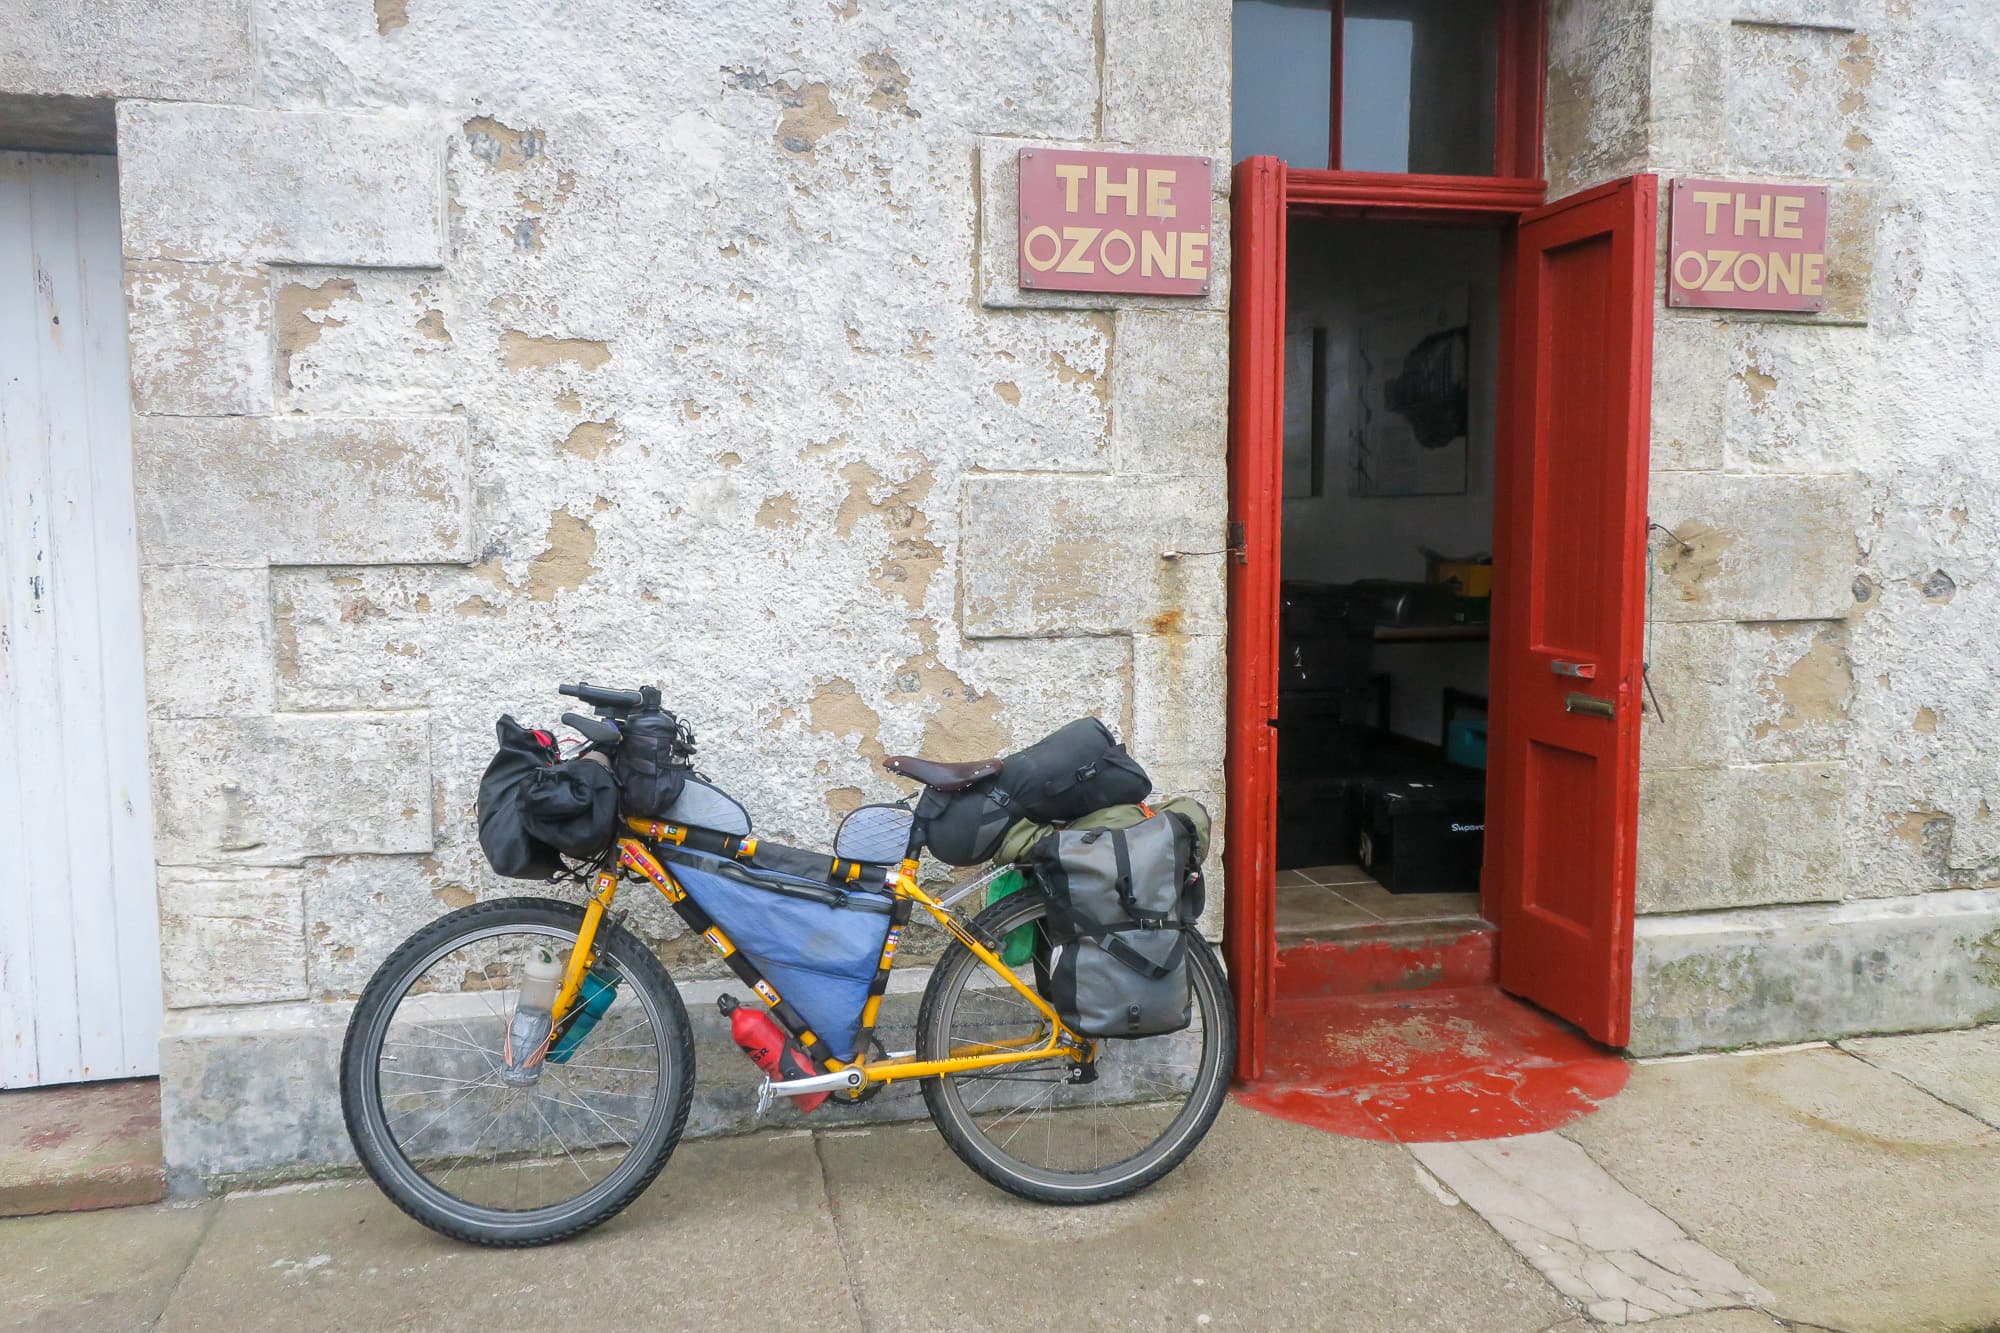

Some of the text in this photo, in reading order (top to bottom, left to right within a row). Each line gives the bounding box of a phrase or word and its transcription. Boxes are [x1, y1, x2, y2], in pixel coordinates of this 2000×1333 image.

[1056, 164, 1177, 218] THE
[1693, 191, 1805, 239] THE
[1024, 225, 1209, 280] OZONE
[1674, 249, 1824, 296] OZONE
